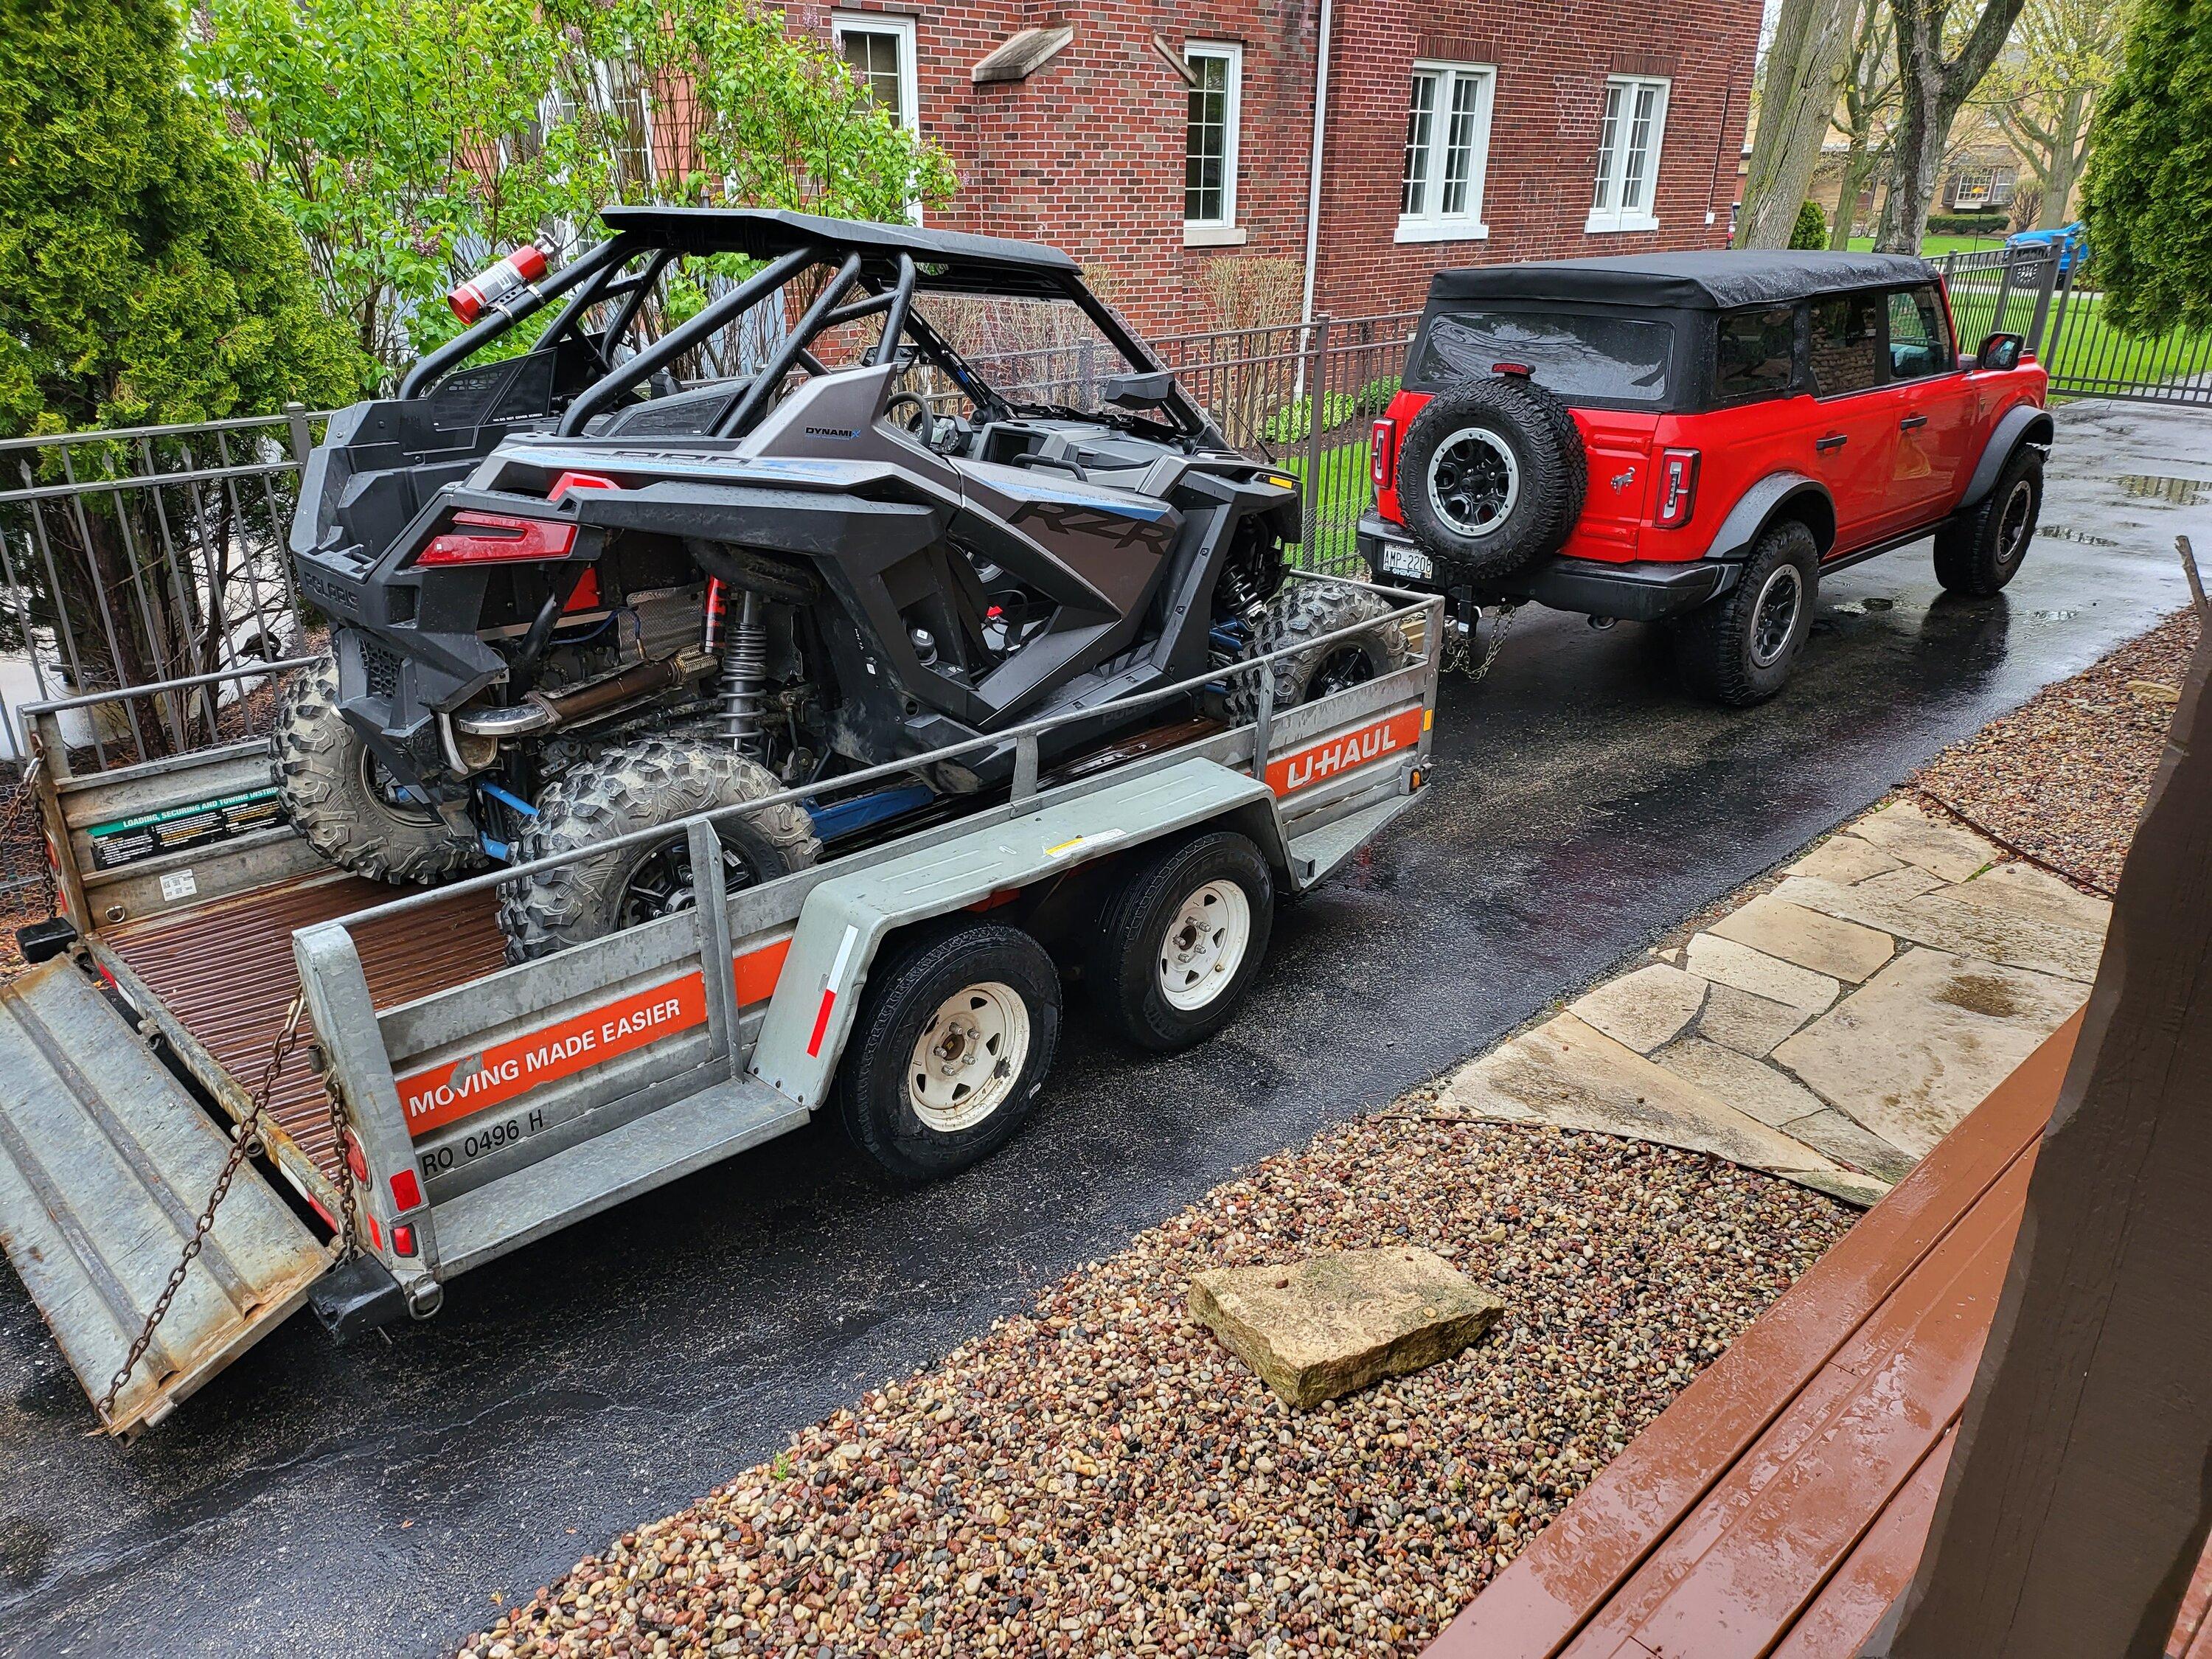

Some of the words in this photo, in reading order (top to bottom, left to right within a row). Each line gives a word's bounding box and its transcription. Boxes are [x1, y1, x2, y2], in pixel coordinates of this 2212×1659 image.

[805, 427, 861, 439] DYNAMIX
[1005, 501, 1176, 555] RZR
[1384, 550, 1432, 573] AMP-2208
[304, 571, 360, 613] POLARIS
[1287, 725, 1397, 789] U-HAUL
[123, 813, 161, 828] LOADING,
[161, 804, 201, 818] SECURING
[201, 800, 218, 810] AND
[219, 793, 248, 806] TOWING
[408, 1060, 519, 1118] MOVING
[526, 1030, 597, 1073] MADE
[602, 998, 681, 1043] EASIER
[422, 1147, 454, 1176] RO
[465, 1119, 520, 1158] 0496
[529, 1109, 544, 1132] H
